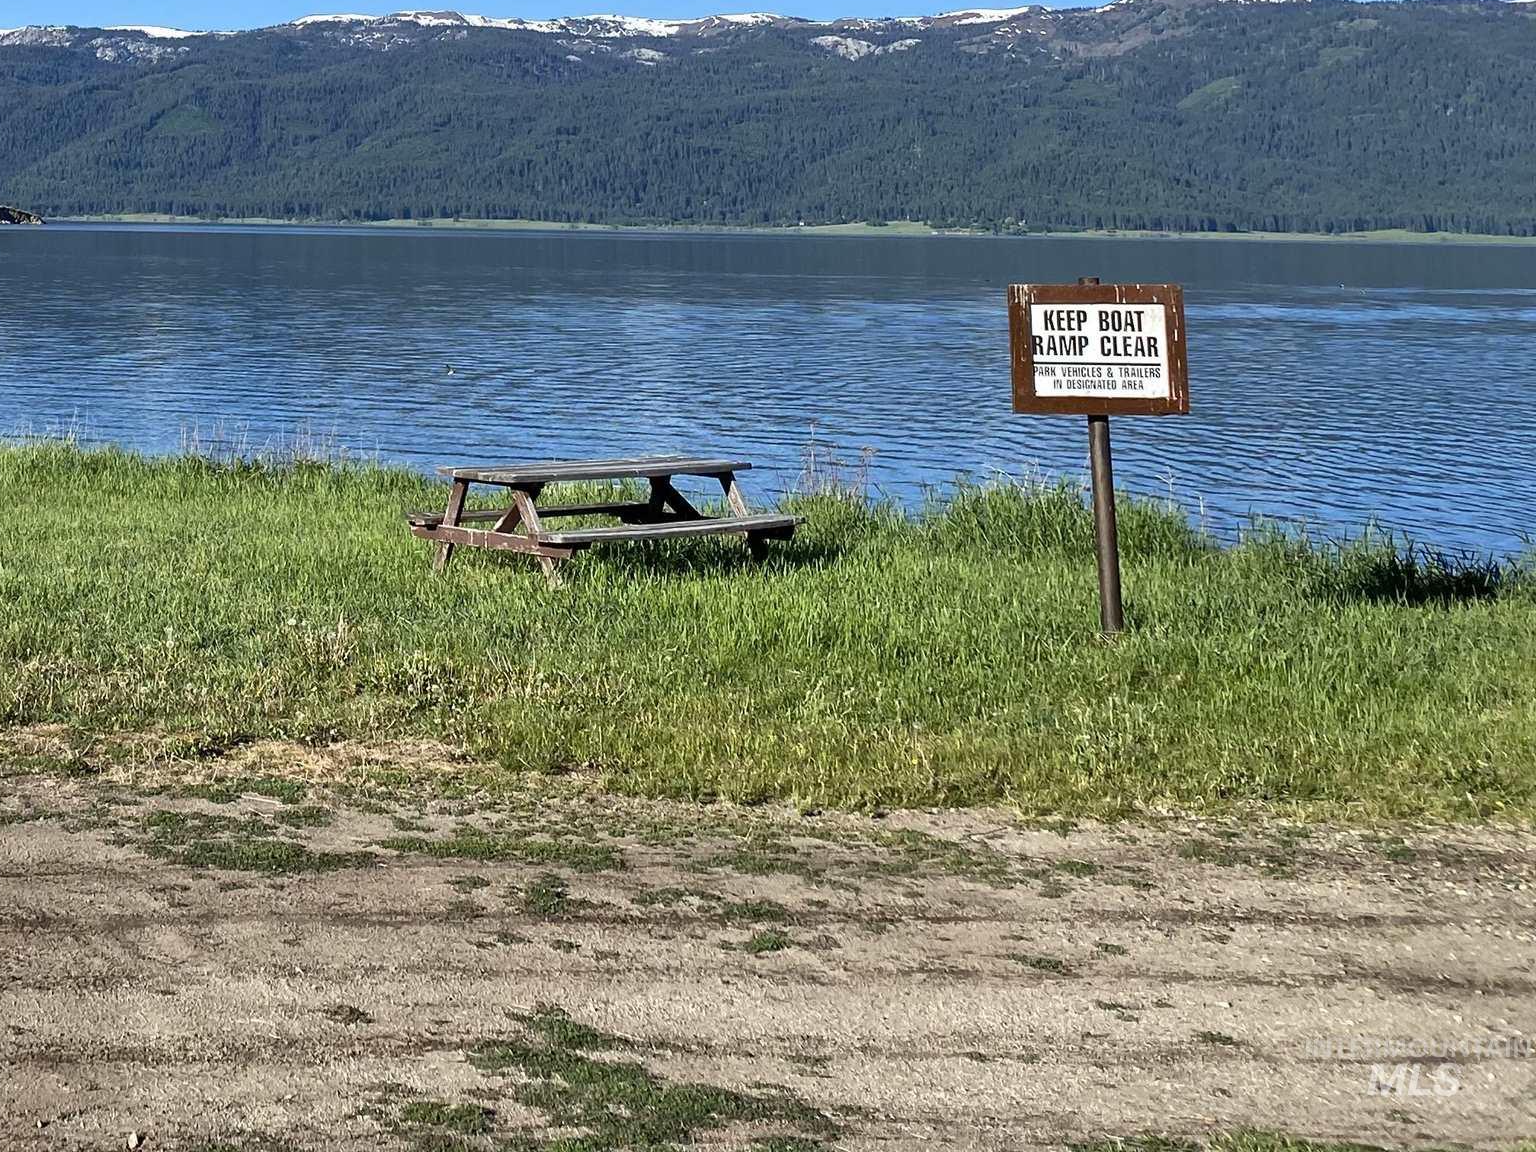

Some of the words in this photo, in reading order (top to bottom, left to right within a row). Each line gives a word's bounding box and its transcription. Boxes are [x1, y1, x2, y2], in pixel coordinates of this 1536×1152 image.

[1044, 310, 1088, 331] KEEP
[1098, 310, 1144, 332] BOAT
[1032, 335, 1089, 356] RAMP
[1100, 336, 1159, 357] CLEAR
[1061, 366, 1102, 378] VEHICLES
[1107, 368, 1114, 378] &
[1119, 367, 1161, 378] TRAILERS
[1053, 379, 1063, 389] IN
[1067, 379, 1117, 390] DESIGNATED
[1122, 379, 1144, 390] AREA
